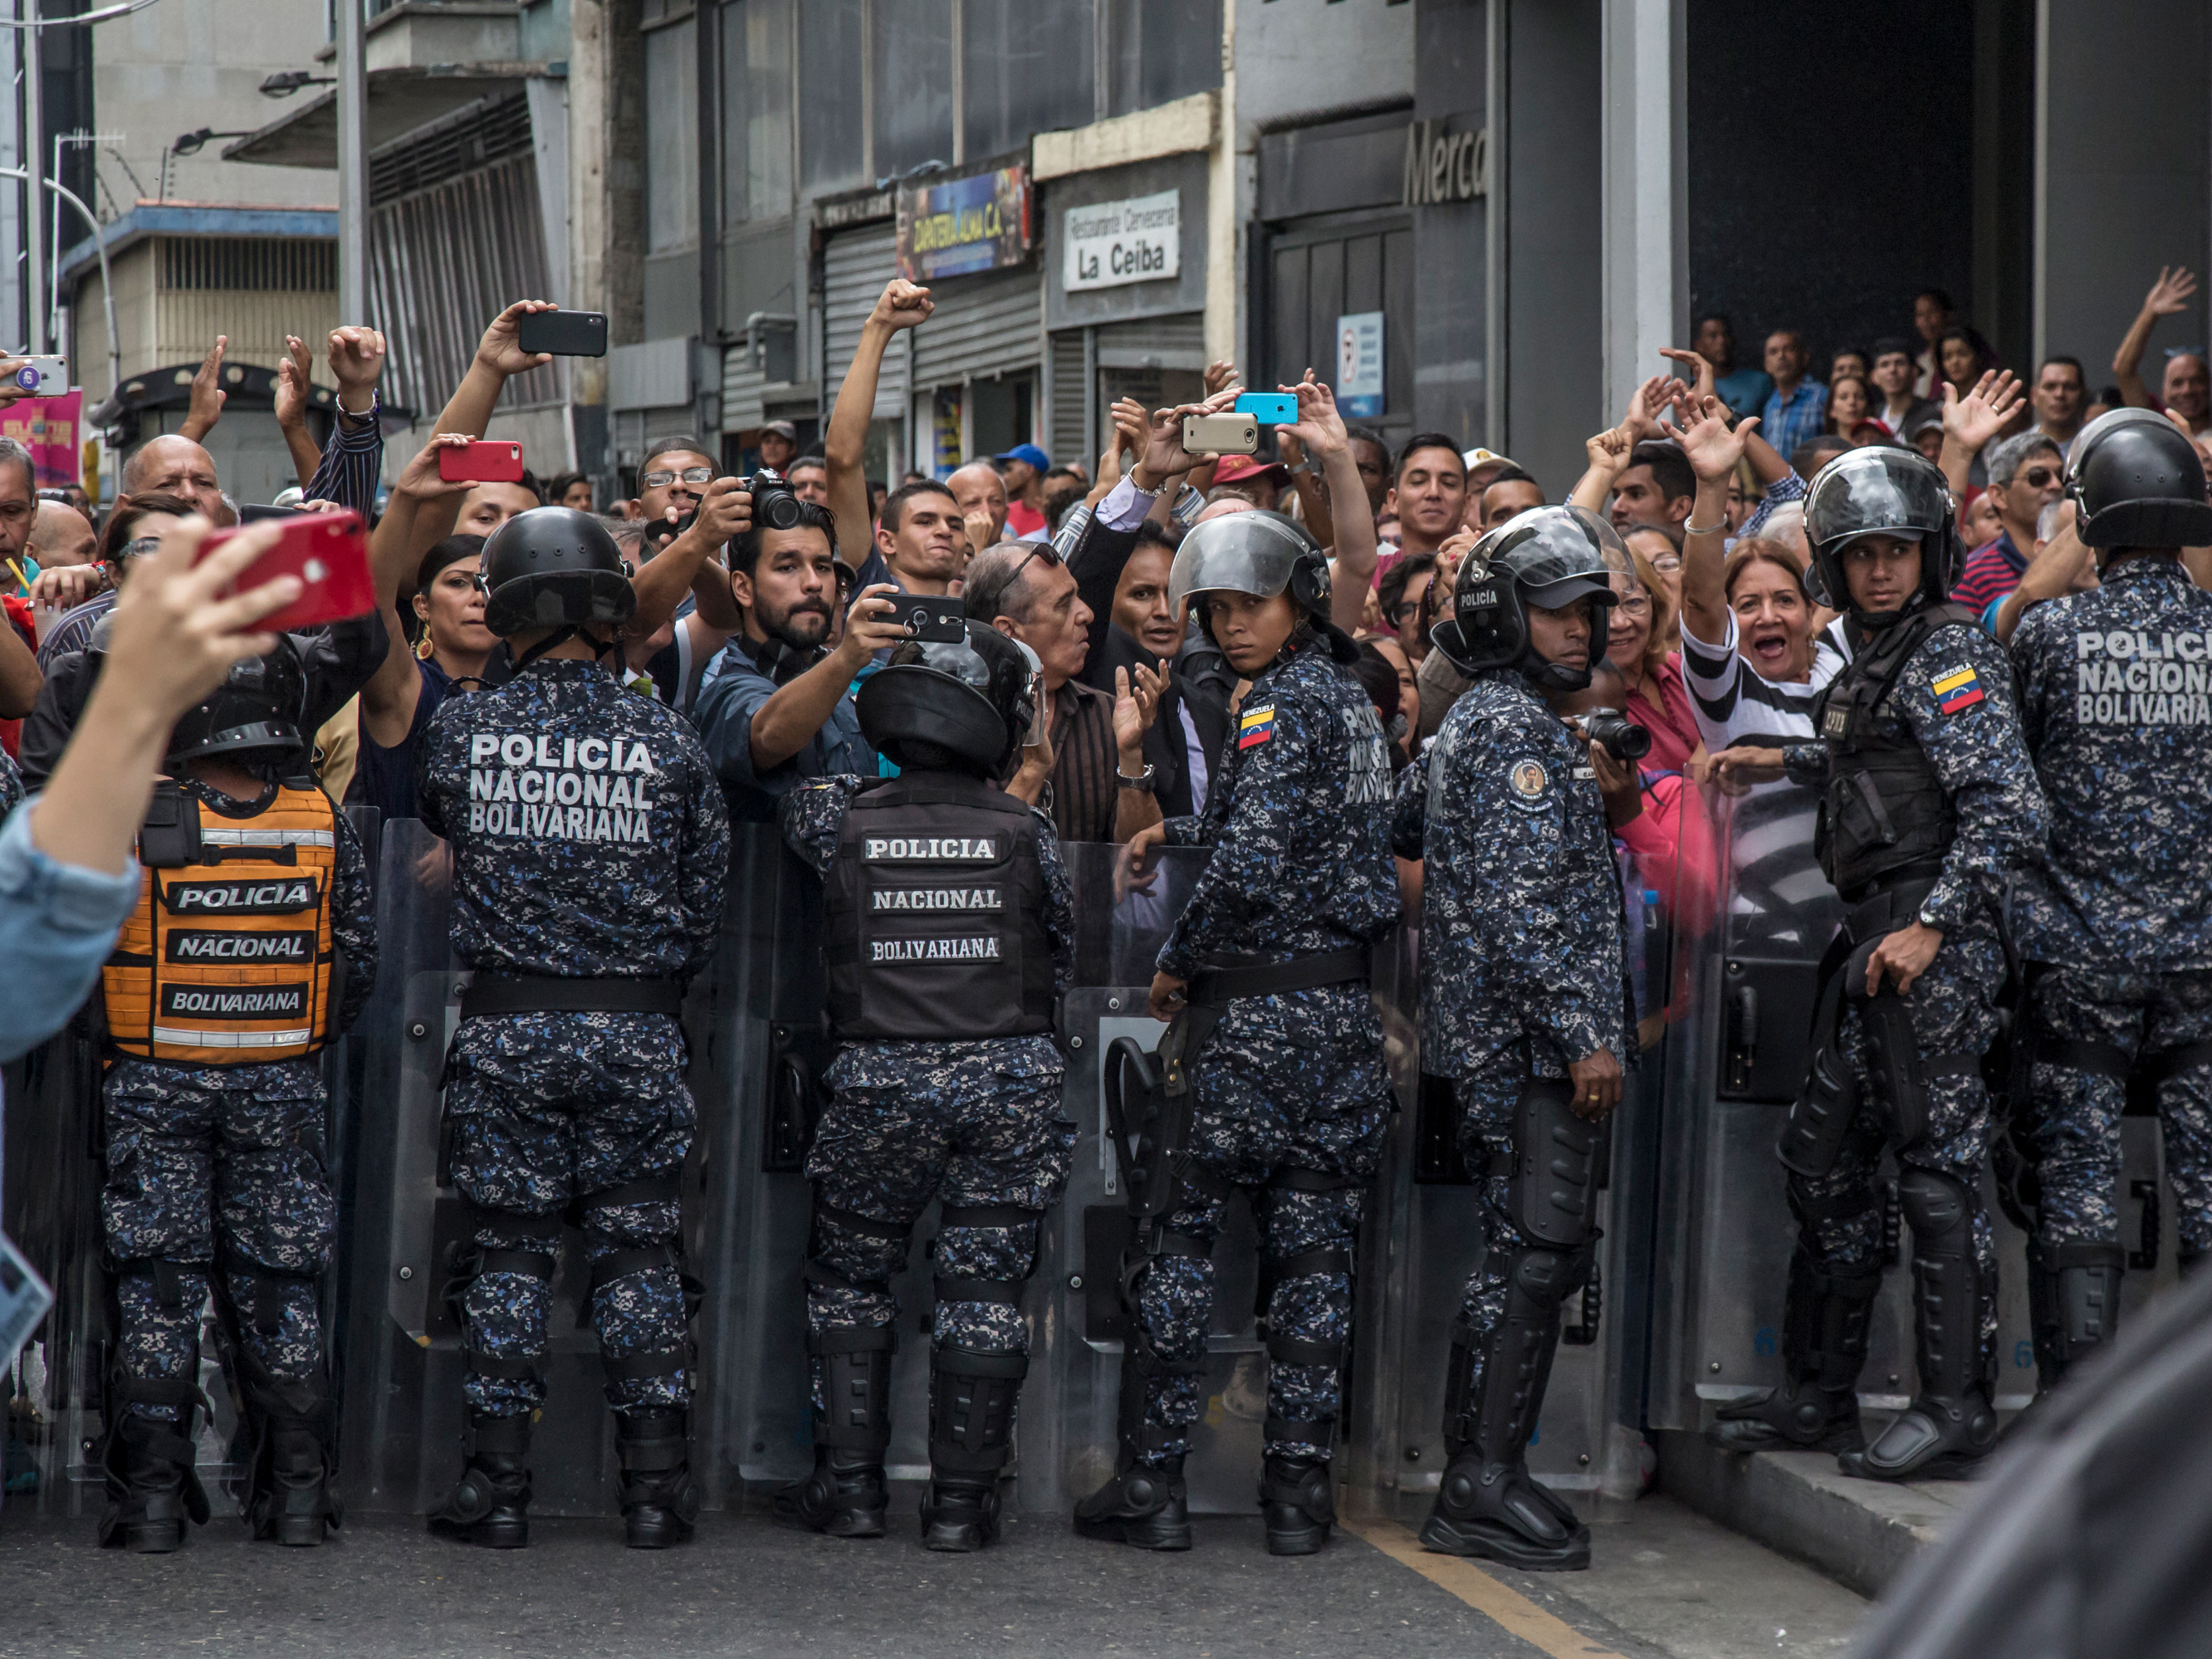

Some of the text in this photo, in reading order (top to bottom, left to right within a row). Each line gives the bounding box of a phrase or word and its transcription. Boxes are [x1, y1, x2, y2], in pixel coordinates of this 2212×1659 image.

[1079, 238, 1164, 280] La Ceiba
[1461, 589, 1498, 608] POLICÍA
[1930, 662, 1973, 684] VENEZUELA
[2078, 662, 2212, 693] NACION
[1242, 702, 1275, 718] VENEZUELA
[470, 734, 654, 774] POLICÍA
[469, 769, 653, 810] NACIONAL
[469, 802, 650, 843] BOLIVARIANA
[868, 839, 995, 859] POLICIA
[874, 889, 1001, 909] NACIONAL
[177, 936, 305, 957] NACIONAL
[872, 937, 999, 961] BOLIVARIANA
[172, 991, 299, 1011] BOLIVARIANA
